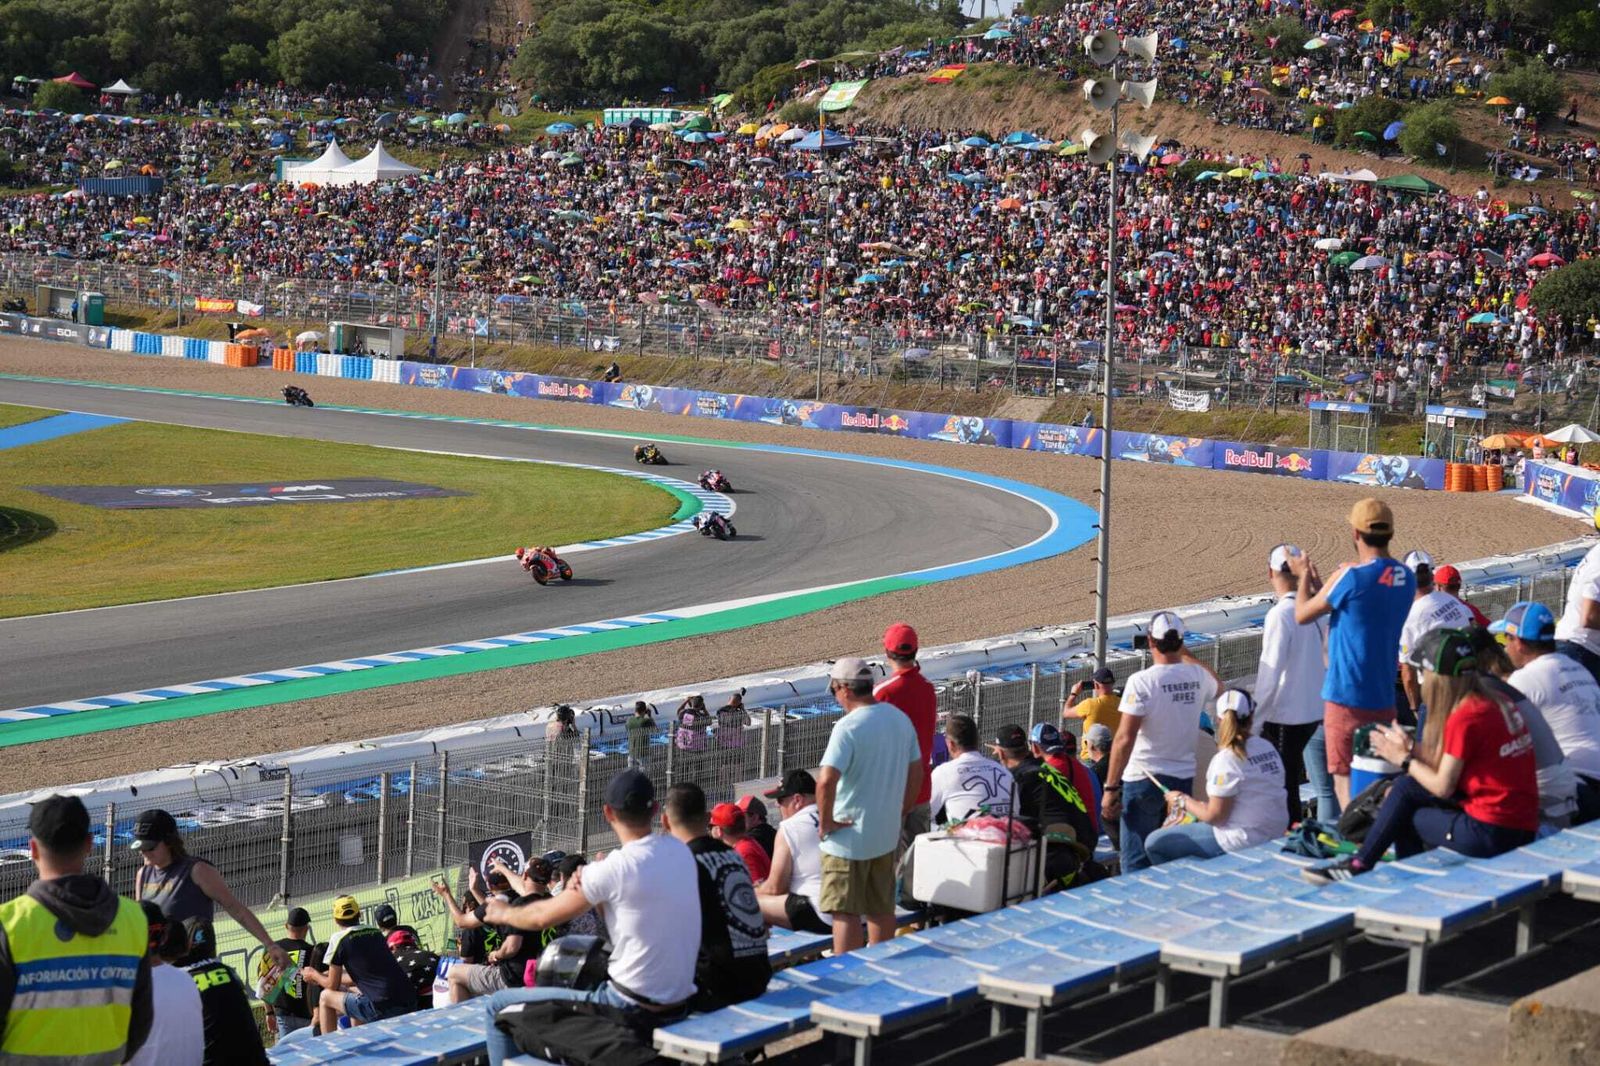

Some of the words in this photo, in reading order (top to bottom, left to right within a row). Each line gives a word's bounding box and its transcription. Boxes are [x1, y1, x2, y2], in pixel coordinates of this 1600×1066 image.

[1378, 566, 1406, 588] 42
[1161, 681, 1200, 693] TENERIFE
[90, 967, 99, 980] Y
[193, 967, 231, 992] 46
